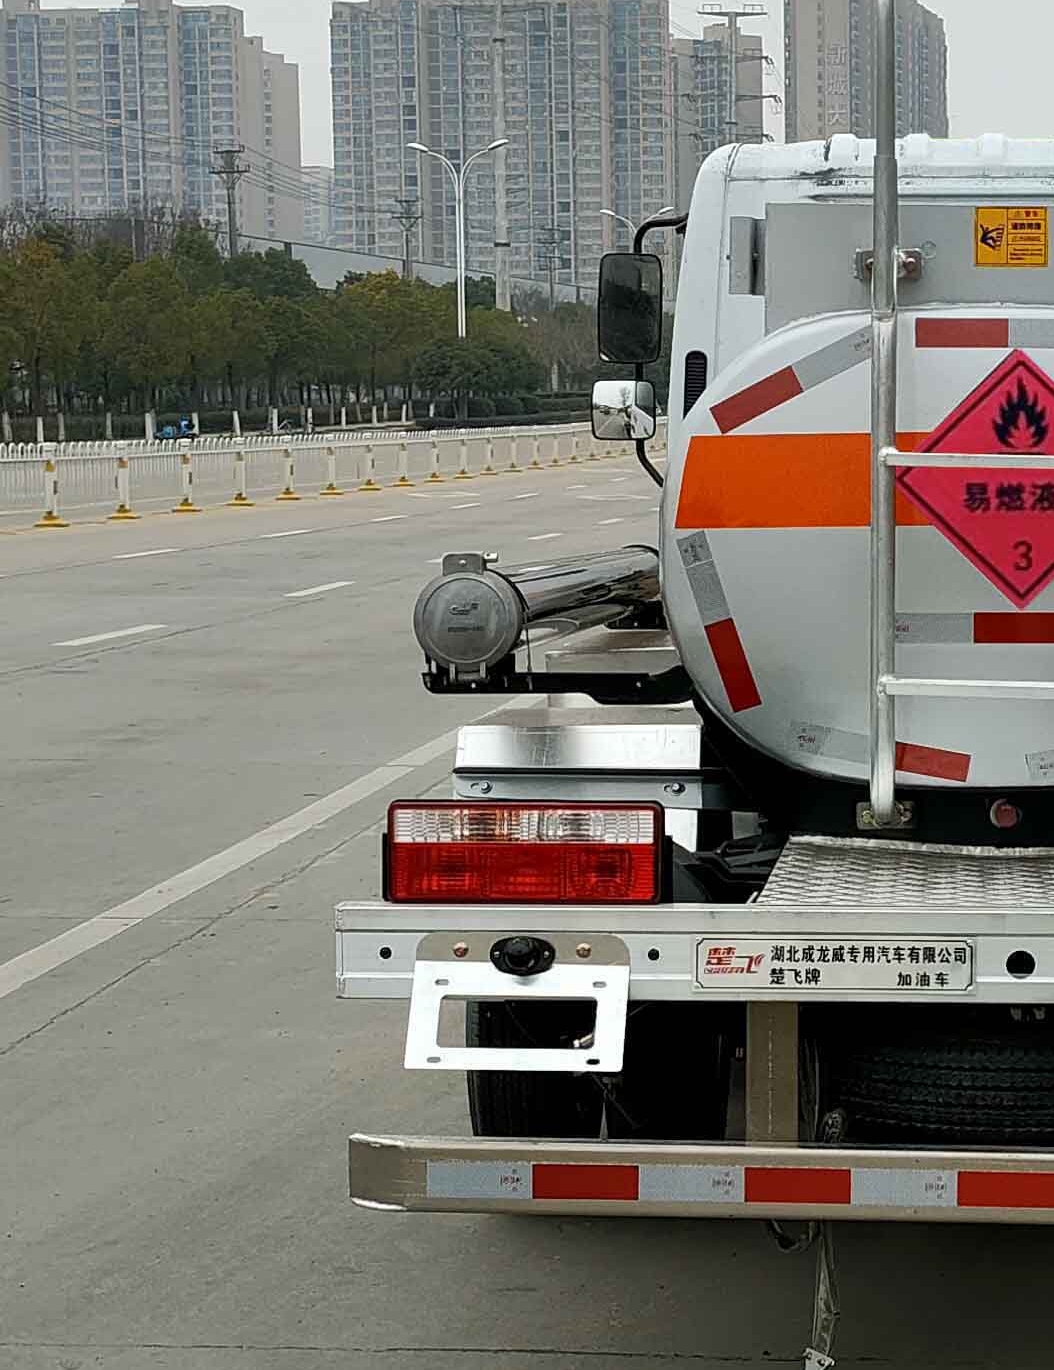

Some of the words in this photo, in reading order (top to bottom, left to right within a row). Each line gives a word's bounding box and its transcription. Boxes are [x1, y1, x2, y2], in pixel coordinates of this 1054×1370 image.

[1013, 540, 1034, 572] 3
[770, 944, 968, 965] 湖北成龙威专用汽车有限公司
[769, 966, 822, 986] 楚飞牌
[897, 971, 950, 987] 加油车
